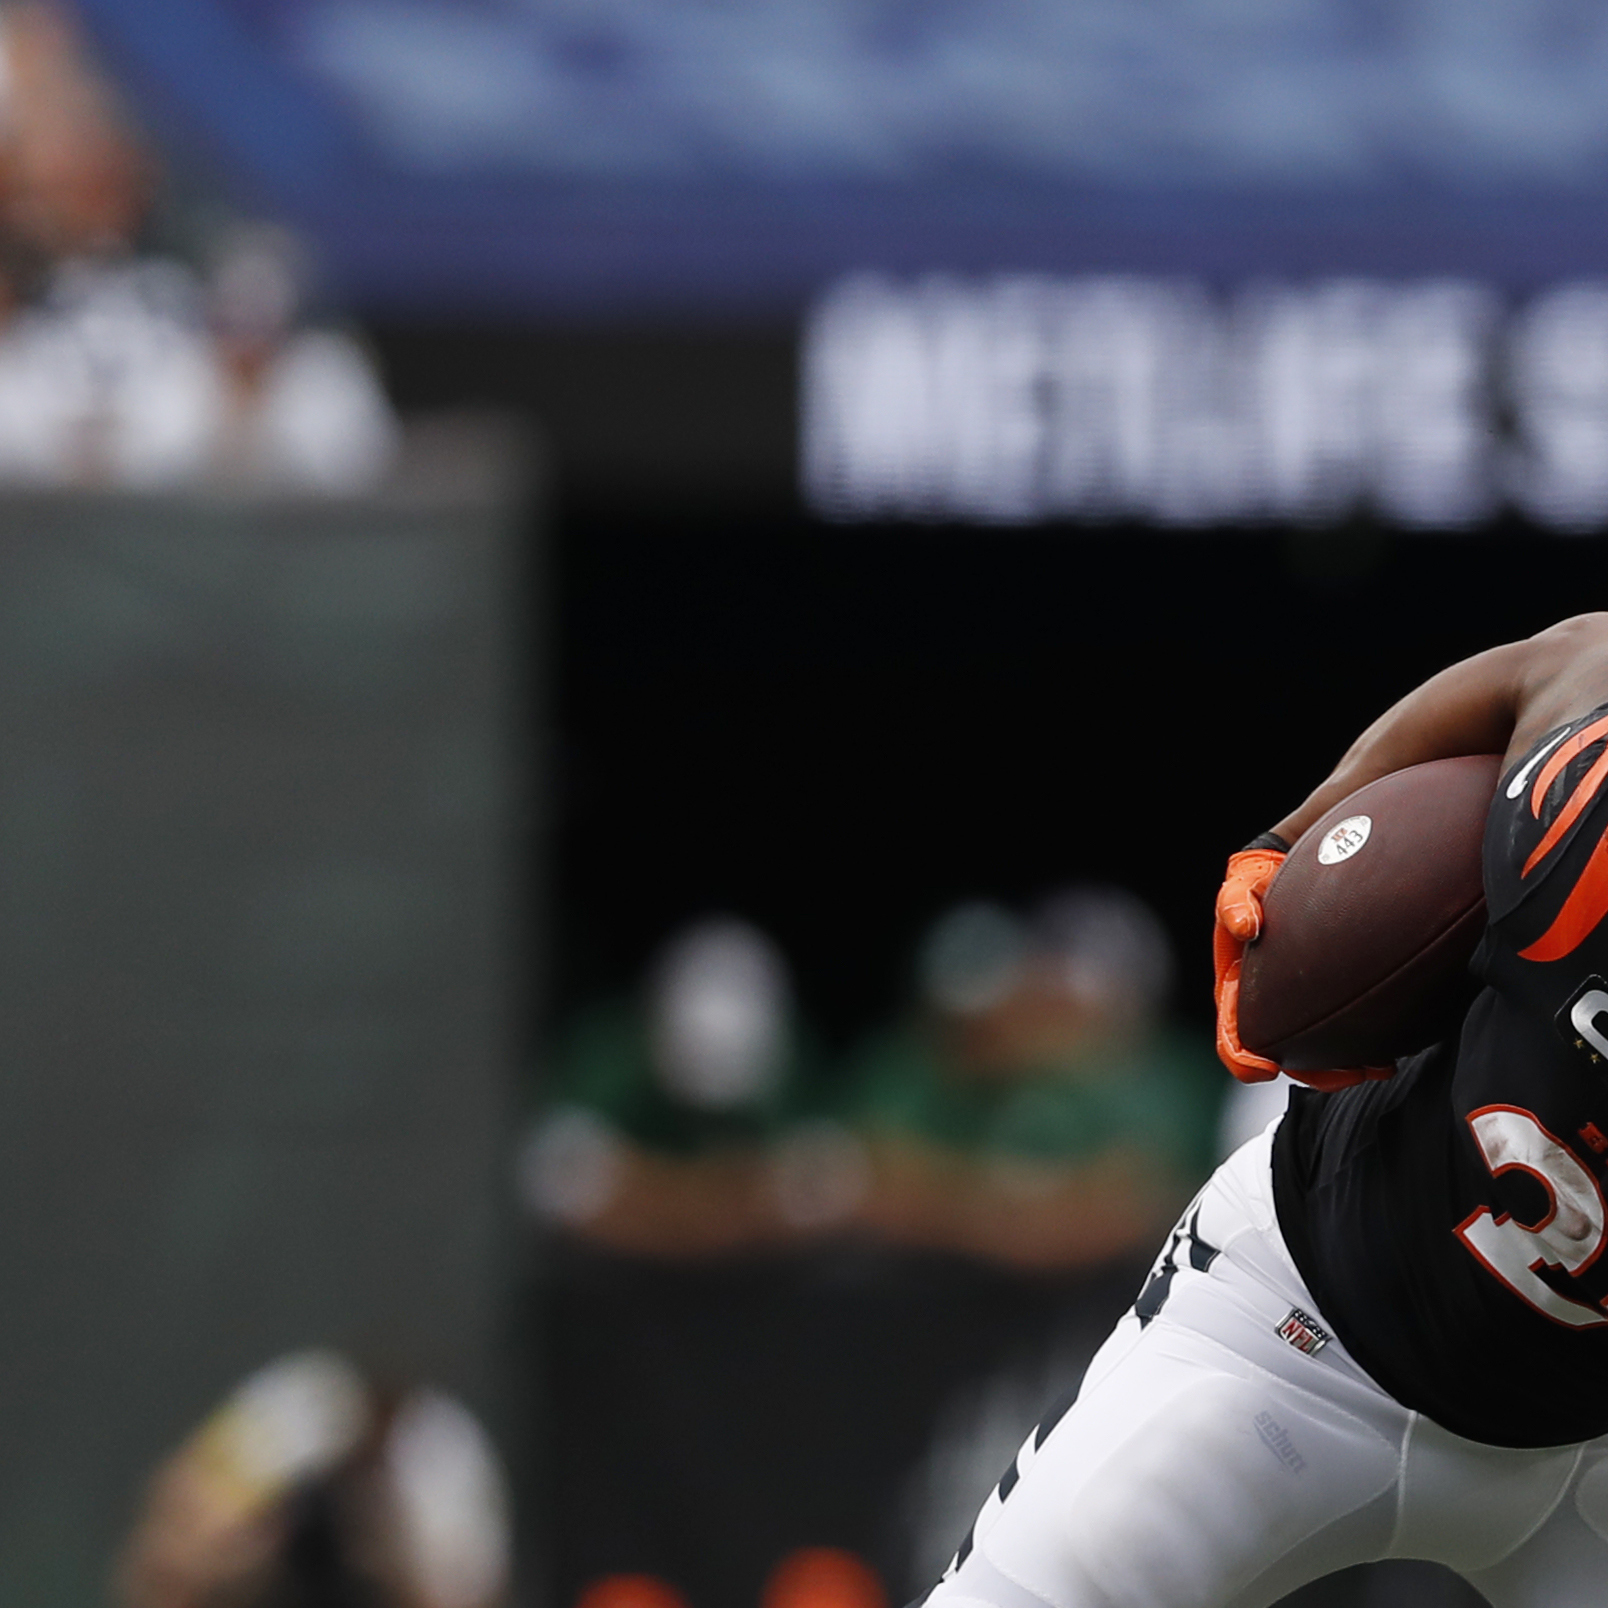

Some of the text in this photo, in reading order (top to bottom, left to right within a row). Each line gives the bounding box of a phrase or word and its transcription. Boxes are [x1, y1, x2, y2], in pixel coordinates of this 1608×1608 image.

[800, 275, 1492, 525] METLIFE
[1336, 829, 1364, 857] 443
[1281, 1318, 1315, 1353] NFL
